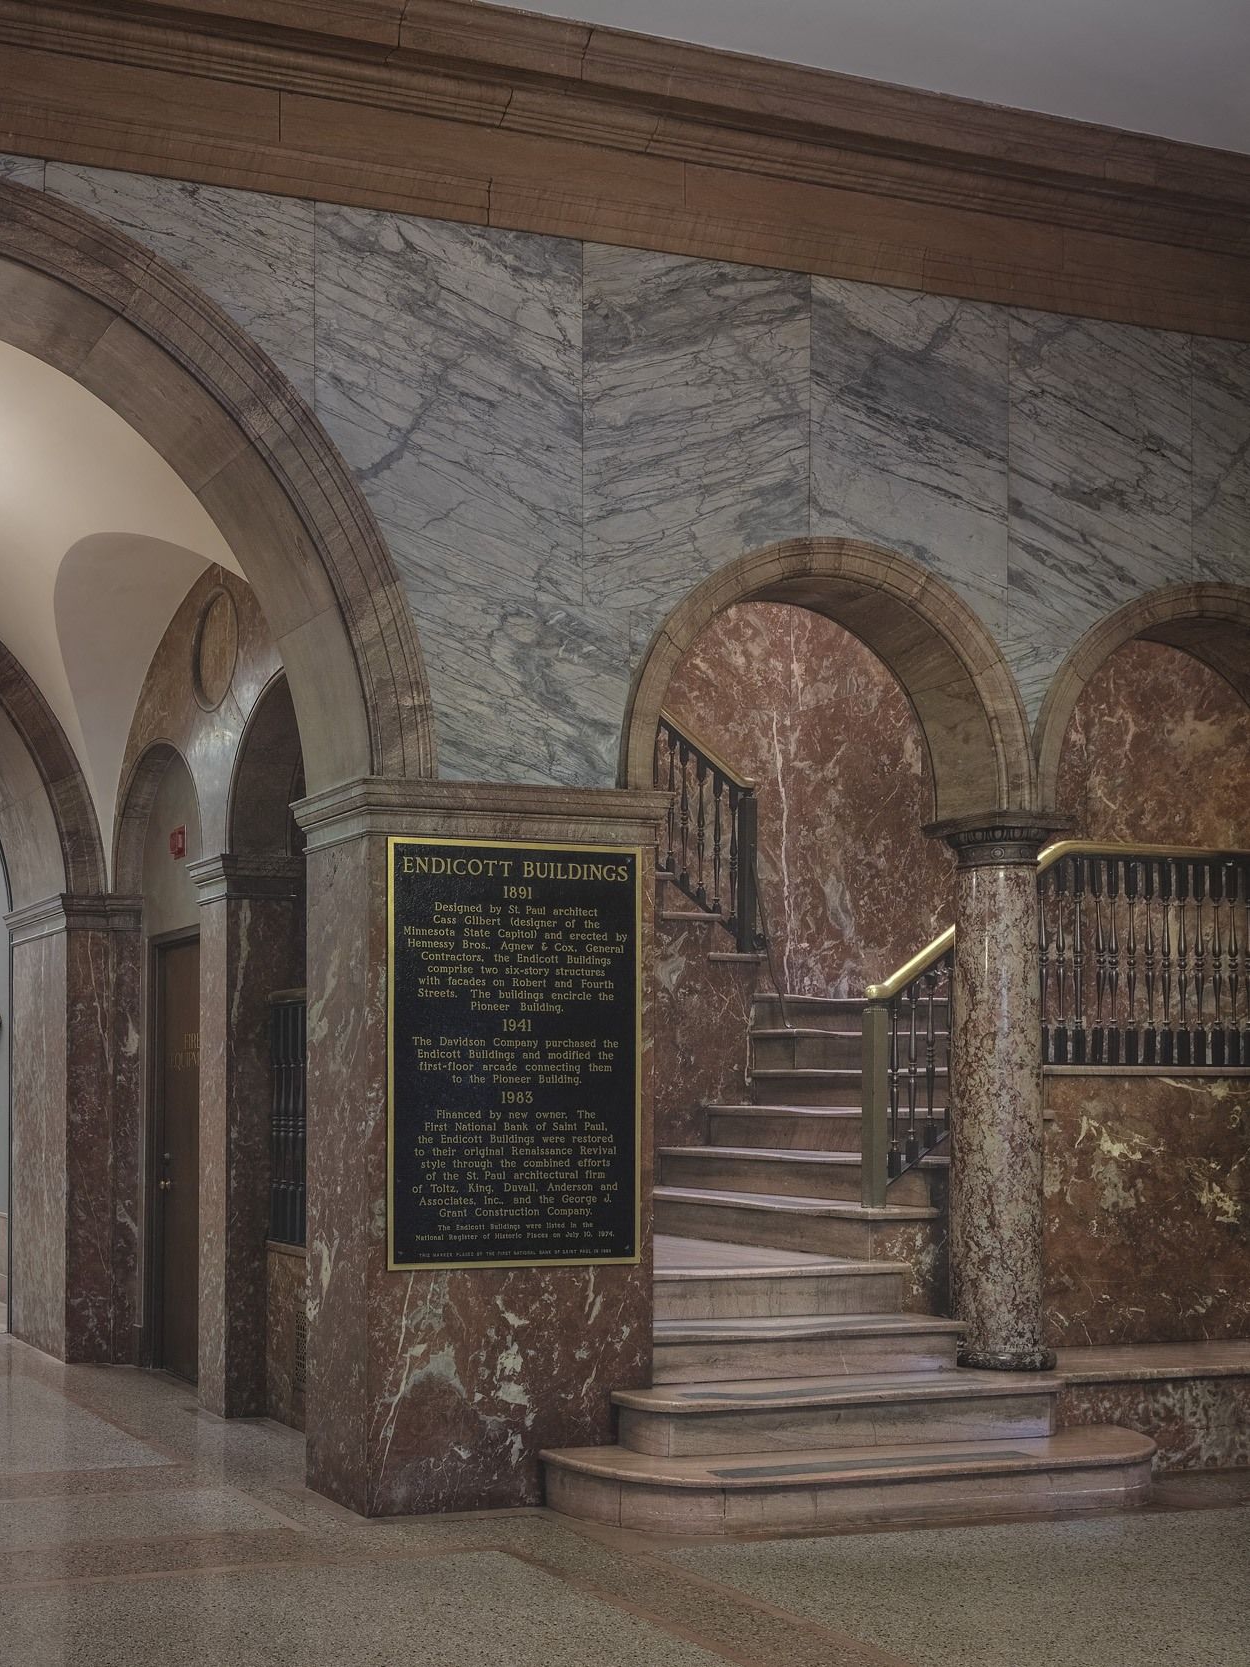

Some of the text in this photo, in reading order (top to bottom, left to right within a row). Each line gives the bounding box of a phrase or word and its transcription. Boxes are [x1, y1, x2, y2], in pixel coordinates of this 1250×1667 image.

[402, 856, 628, 882] ENDICOTT BUILDINGS
[503, 885, 532, 899] 1891
[434, 902, 598, 917] Designed by St. Paul architect
[432, 914, 600, 929] Cass Gilbert (designer of the
[403, 925, 628, 943] Minnesota State Capitol) and erected by
[407, 937, 455, 951] Hennessy
[500, 940, 534, 953] Agnew
[541, 941, 548, 951] &
[585, 943, 624, 954] General
[493, 953, 510, 963] the
[516, 953, 559, 964] Endicott
[566, 954, 611, 967] Buildings
[427, 963, 606, 977] comprise two six-story structures
[417, 975, 614, 989] with facades on Robert and Fourth
[417, 987, 614, 1002] Streets. The buildings encircle the
[470, 1000, 564, 1014] Pioneer Building.
[502, 1019, 532, 1032] 1941
[411, 1036, 619, 1049] The Davidson Company purchased the
[417, 1048, 614, 1061] Endicott Buildings and modified the
[418, 1061, 612, 1074] first-floor arcade connecting them
[451, 1073, 582, 1086] to the Pioneer Building.
[501, 1091, 534, 1104] 1983
[436, 1109, 482, 1119] Financed
[489, 1109, 502, 1121] by
[508, 1111, 528, 1119] new
[576, 1109, 596, 1119] The
[424, 1121, 447, 1132] First
[454, 1121, 496, 1131] National
[503, 1121, 529, 1131] Bank
[535, 1121, 547, 1131] of
[552, 1121, 577, 1131] Saint
[417, 1133, 614, 1145] the Endicott Buildings were restored
[413, 1145, 617, 1158] to their original Renaissance Revival
[420, 1158, 611, 1170] style through the combined efforts
[425, 1169, 606, 1181] of the St. Paul architectural firm
[412, 1184, 423, 1194] of
[546, 1182, 593, 1192] Anderson
[600, 1181, 618, 1191] and
[513, 1194, 531, 1204] and
[539, 1194, 555, 1204] the
[561, 1194, 597, 1205] George
[603, 1193, 612, 1203] J.
[438, 1206, 592, 1218] Grant Construction Company.
[455, 1223, 485, 1231] Endicott
[489, 1223, 521, 1231] Buildings
[545, 1221, 565, 1229] listed
